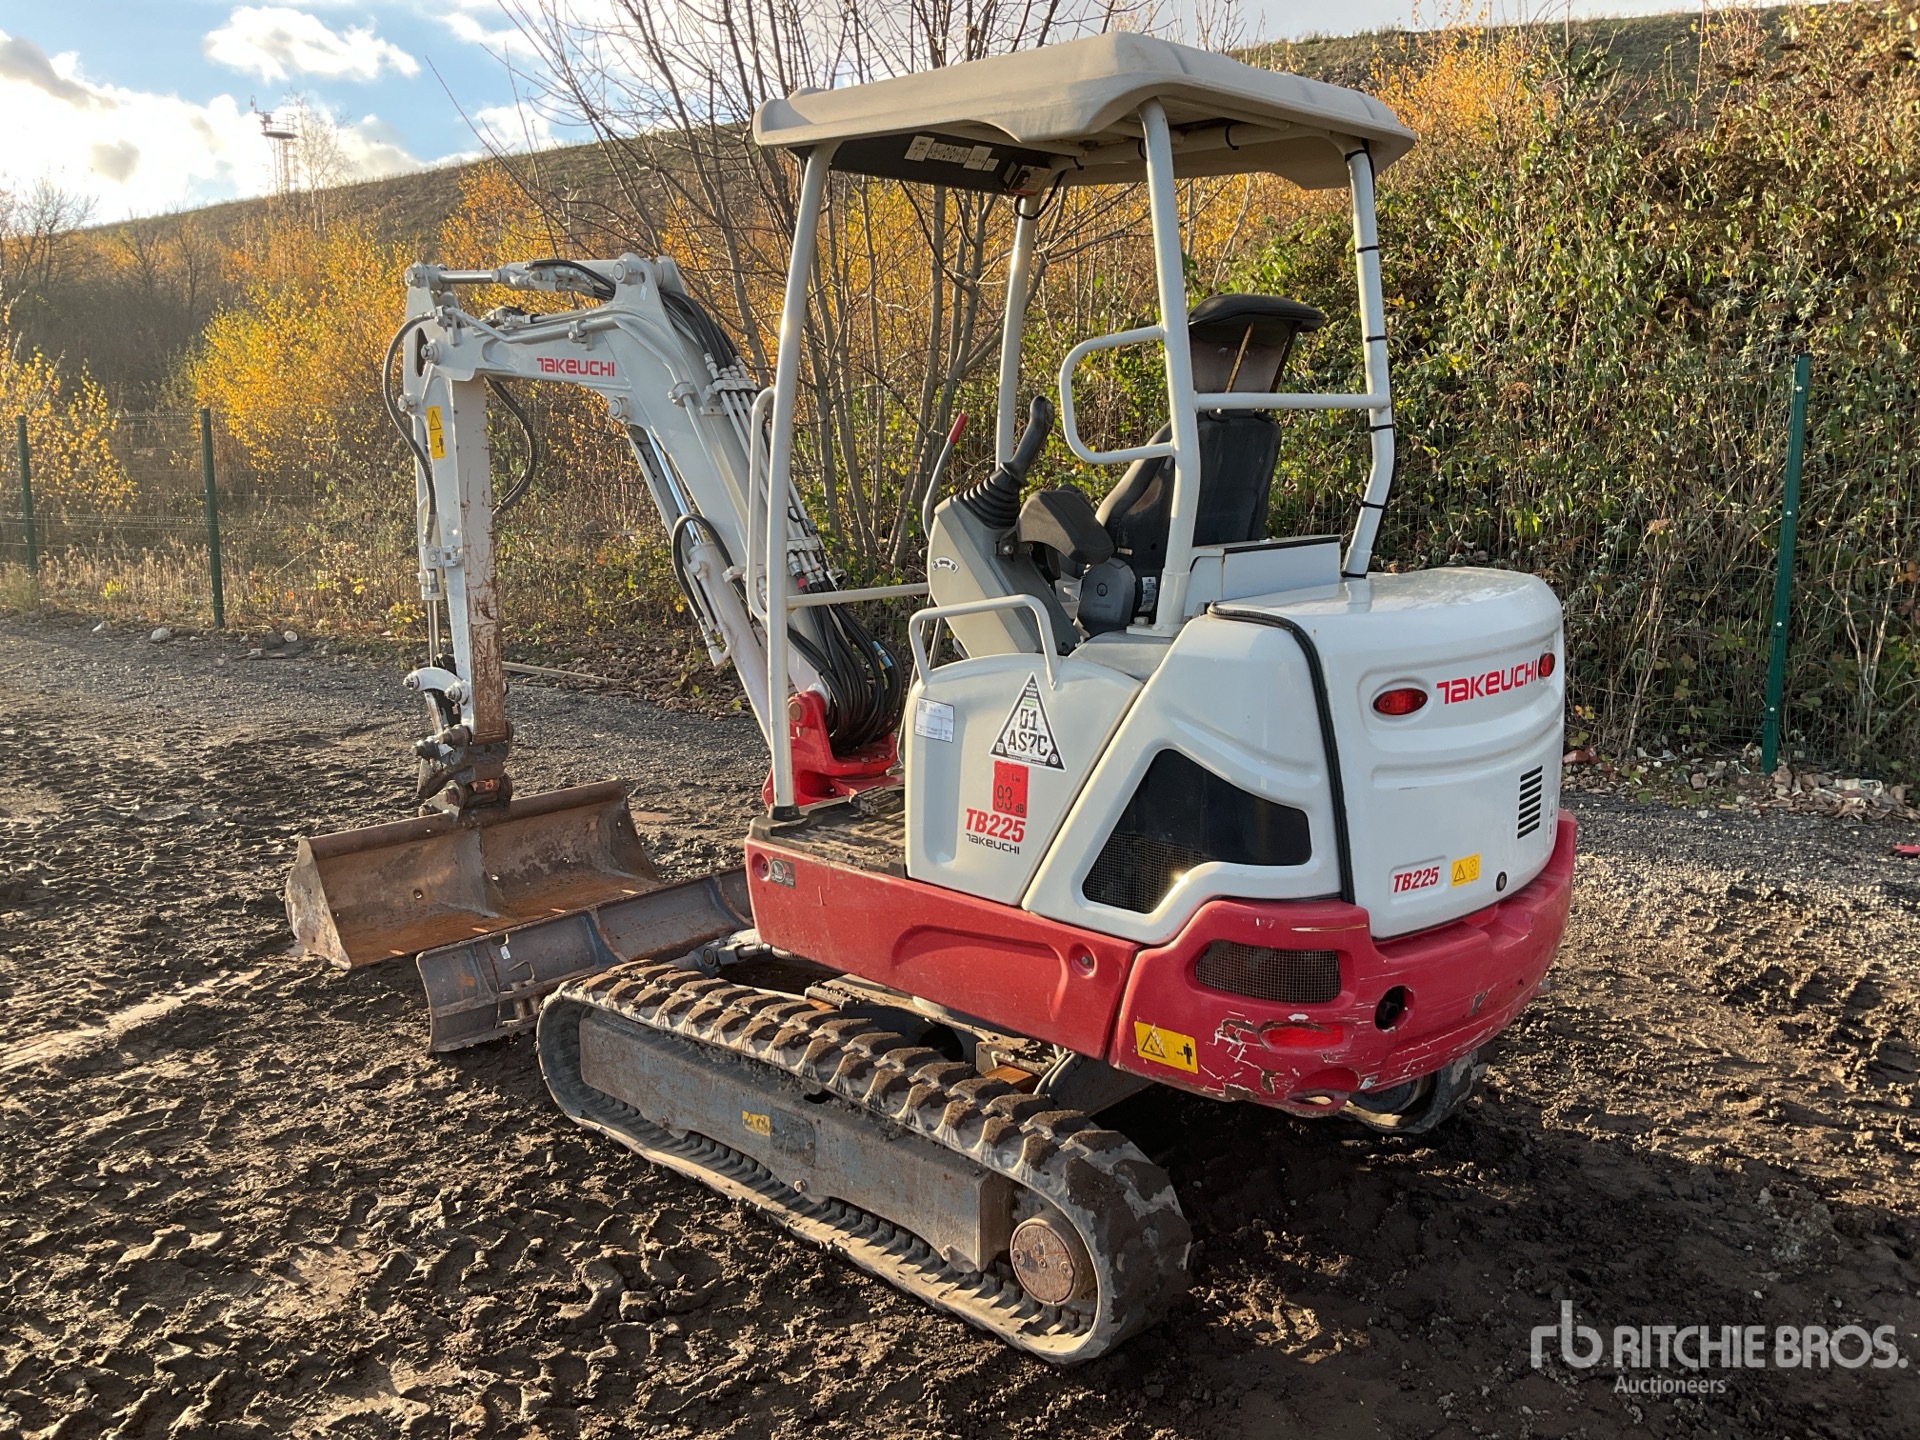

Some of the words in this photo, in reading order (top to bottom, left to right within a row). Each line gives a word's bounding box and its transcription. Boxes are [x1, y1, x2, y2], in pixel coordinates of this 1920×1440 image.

[996, 784, 1013, 811] 93
[1015, 802, 1025, 814] dB
[966, 808, 1026, 843] TB225
[1394, 866, 1440, 893] TB225
